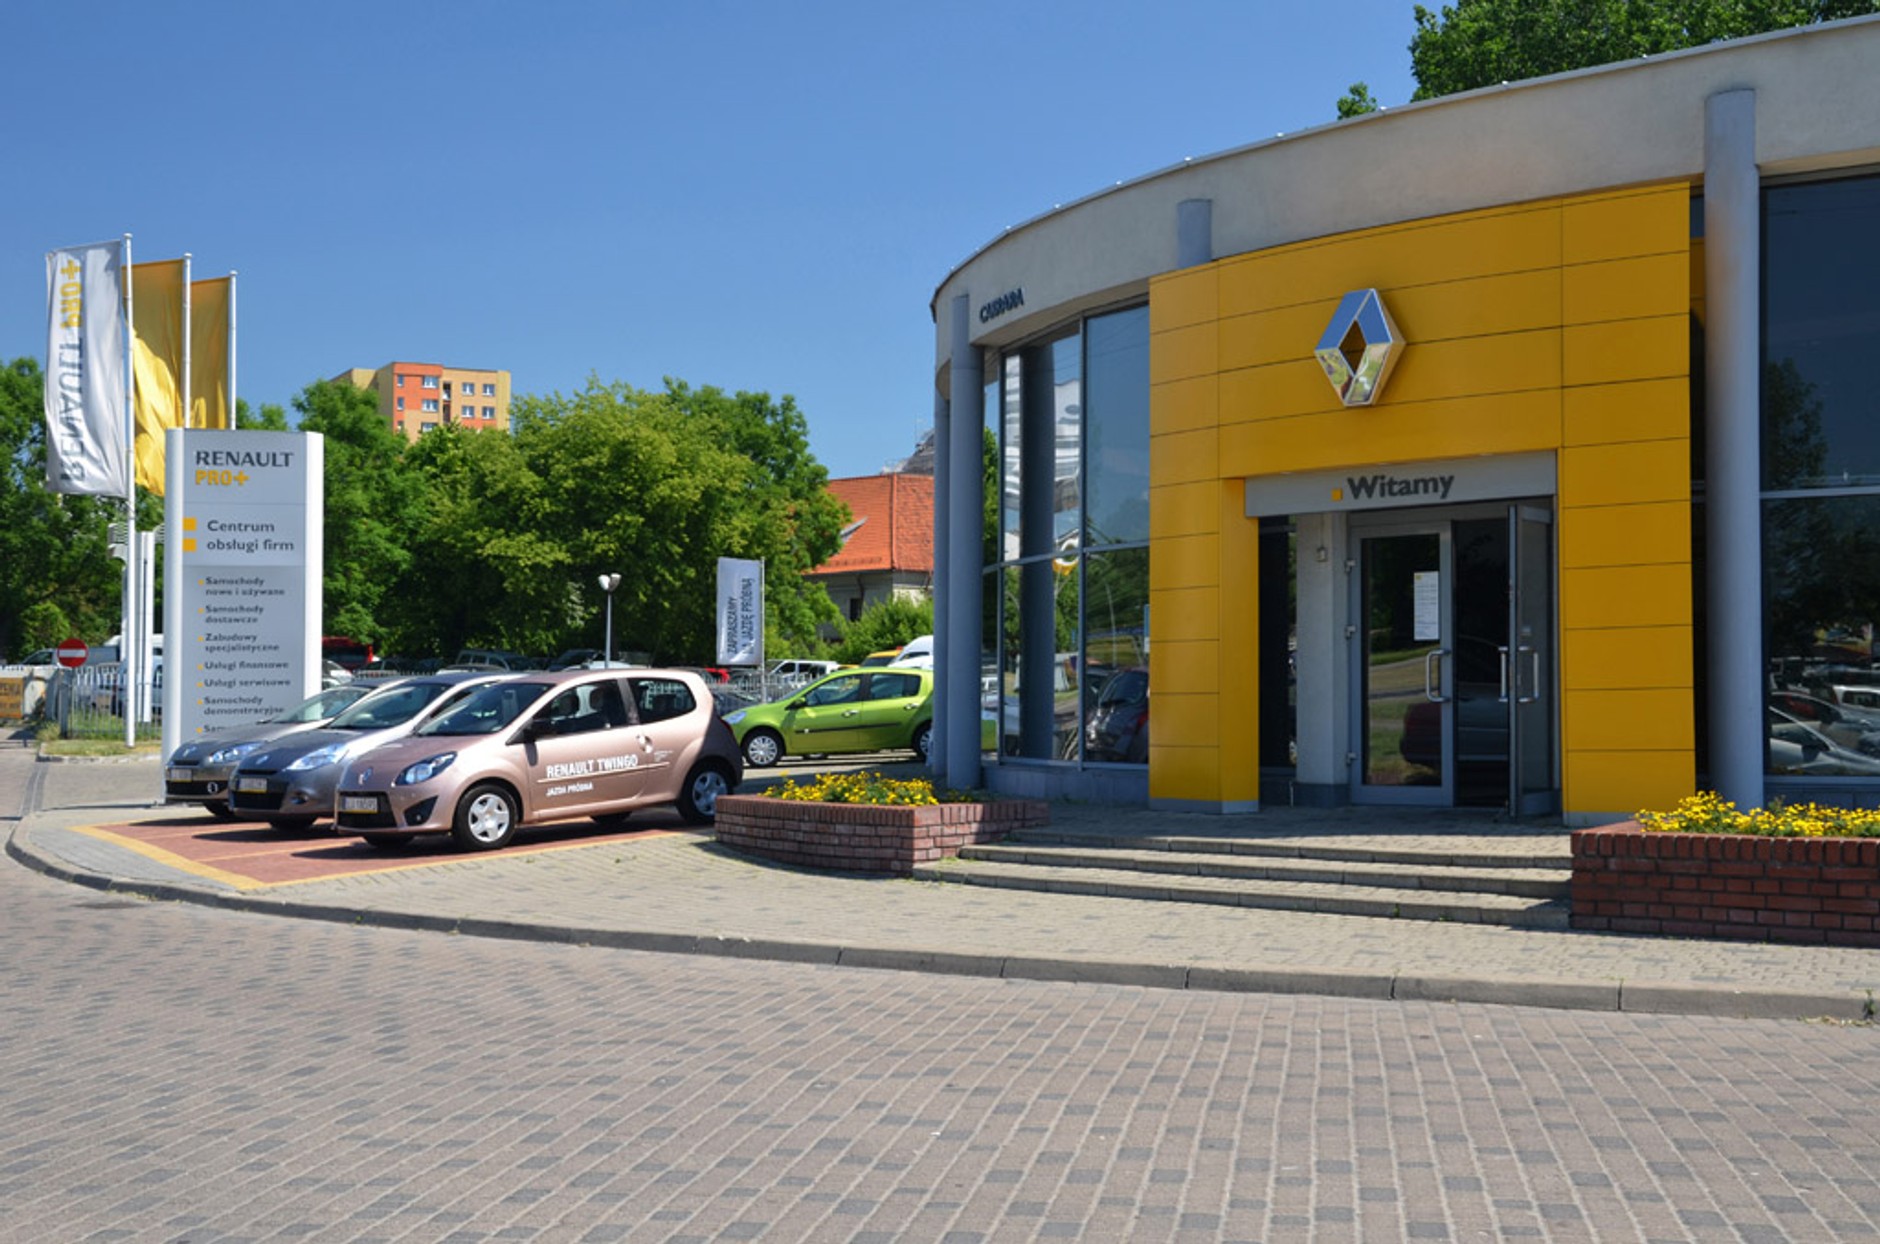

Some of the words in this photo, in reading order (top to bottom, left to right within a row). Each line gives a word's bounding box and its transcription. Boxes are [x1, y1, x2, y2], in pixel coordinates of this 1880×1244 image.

[195, 450, 294, 467] RENAULT
[195, 470, 249, 486] PRO+
[1347, 475, 1455, 499] Witamy
[207, 520, 275, 532] Centrum
[207, 539, 259, 553] obsługi
[263, 539, 294, 551] firm
[205, 576, 265, 587] Samochody
[205, 604, 264, 615] Samochody
[205, 633, 257, 643] Zabudowy
[239, 661, 289, 669] finansowe
[239, 678, 291, 687] serwisowe
[203, 696, 264, 706] Samochody
[546, 759, 594, 778] RENAULT
[597, 754, 639, 772] TWINGO
